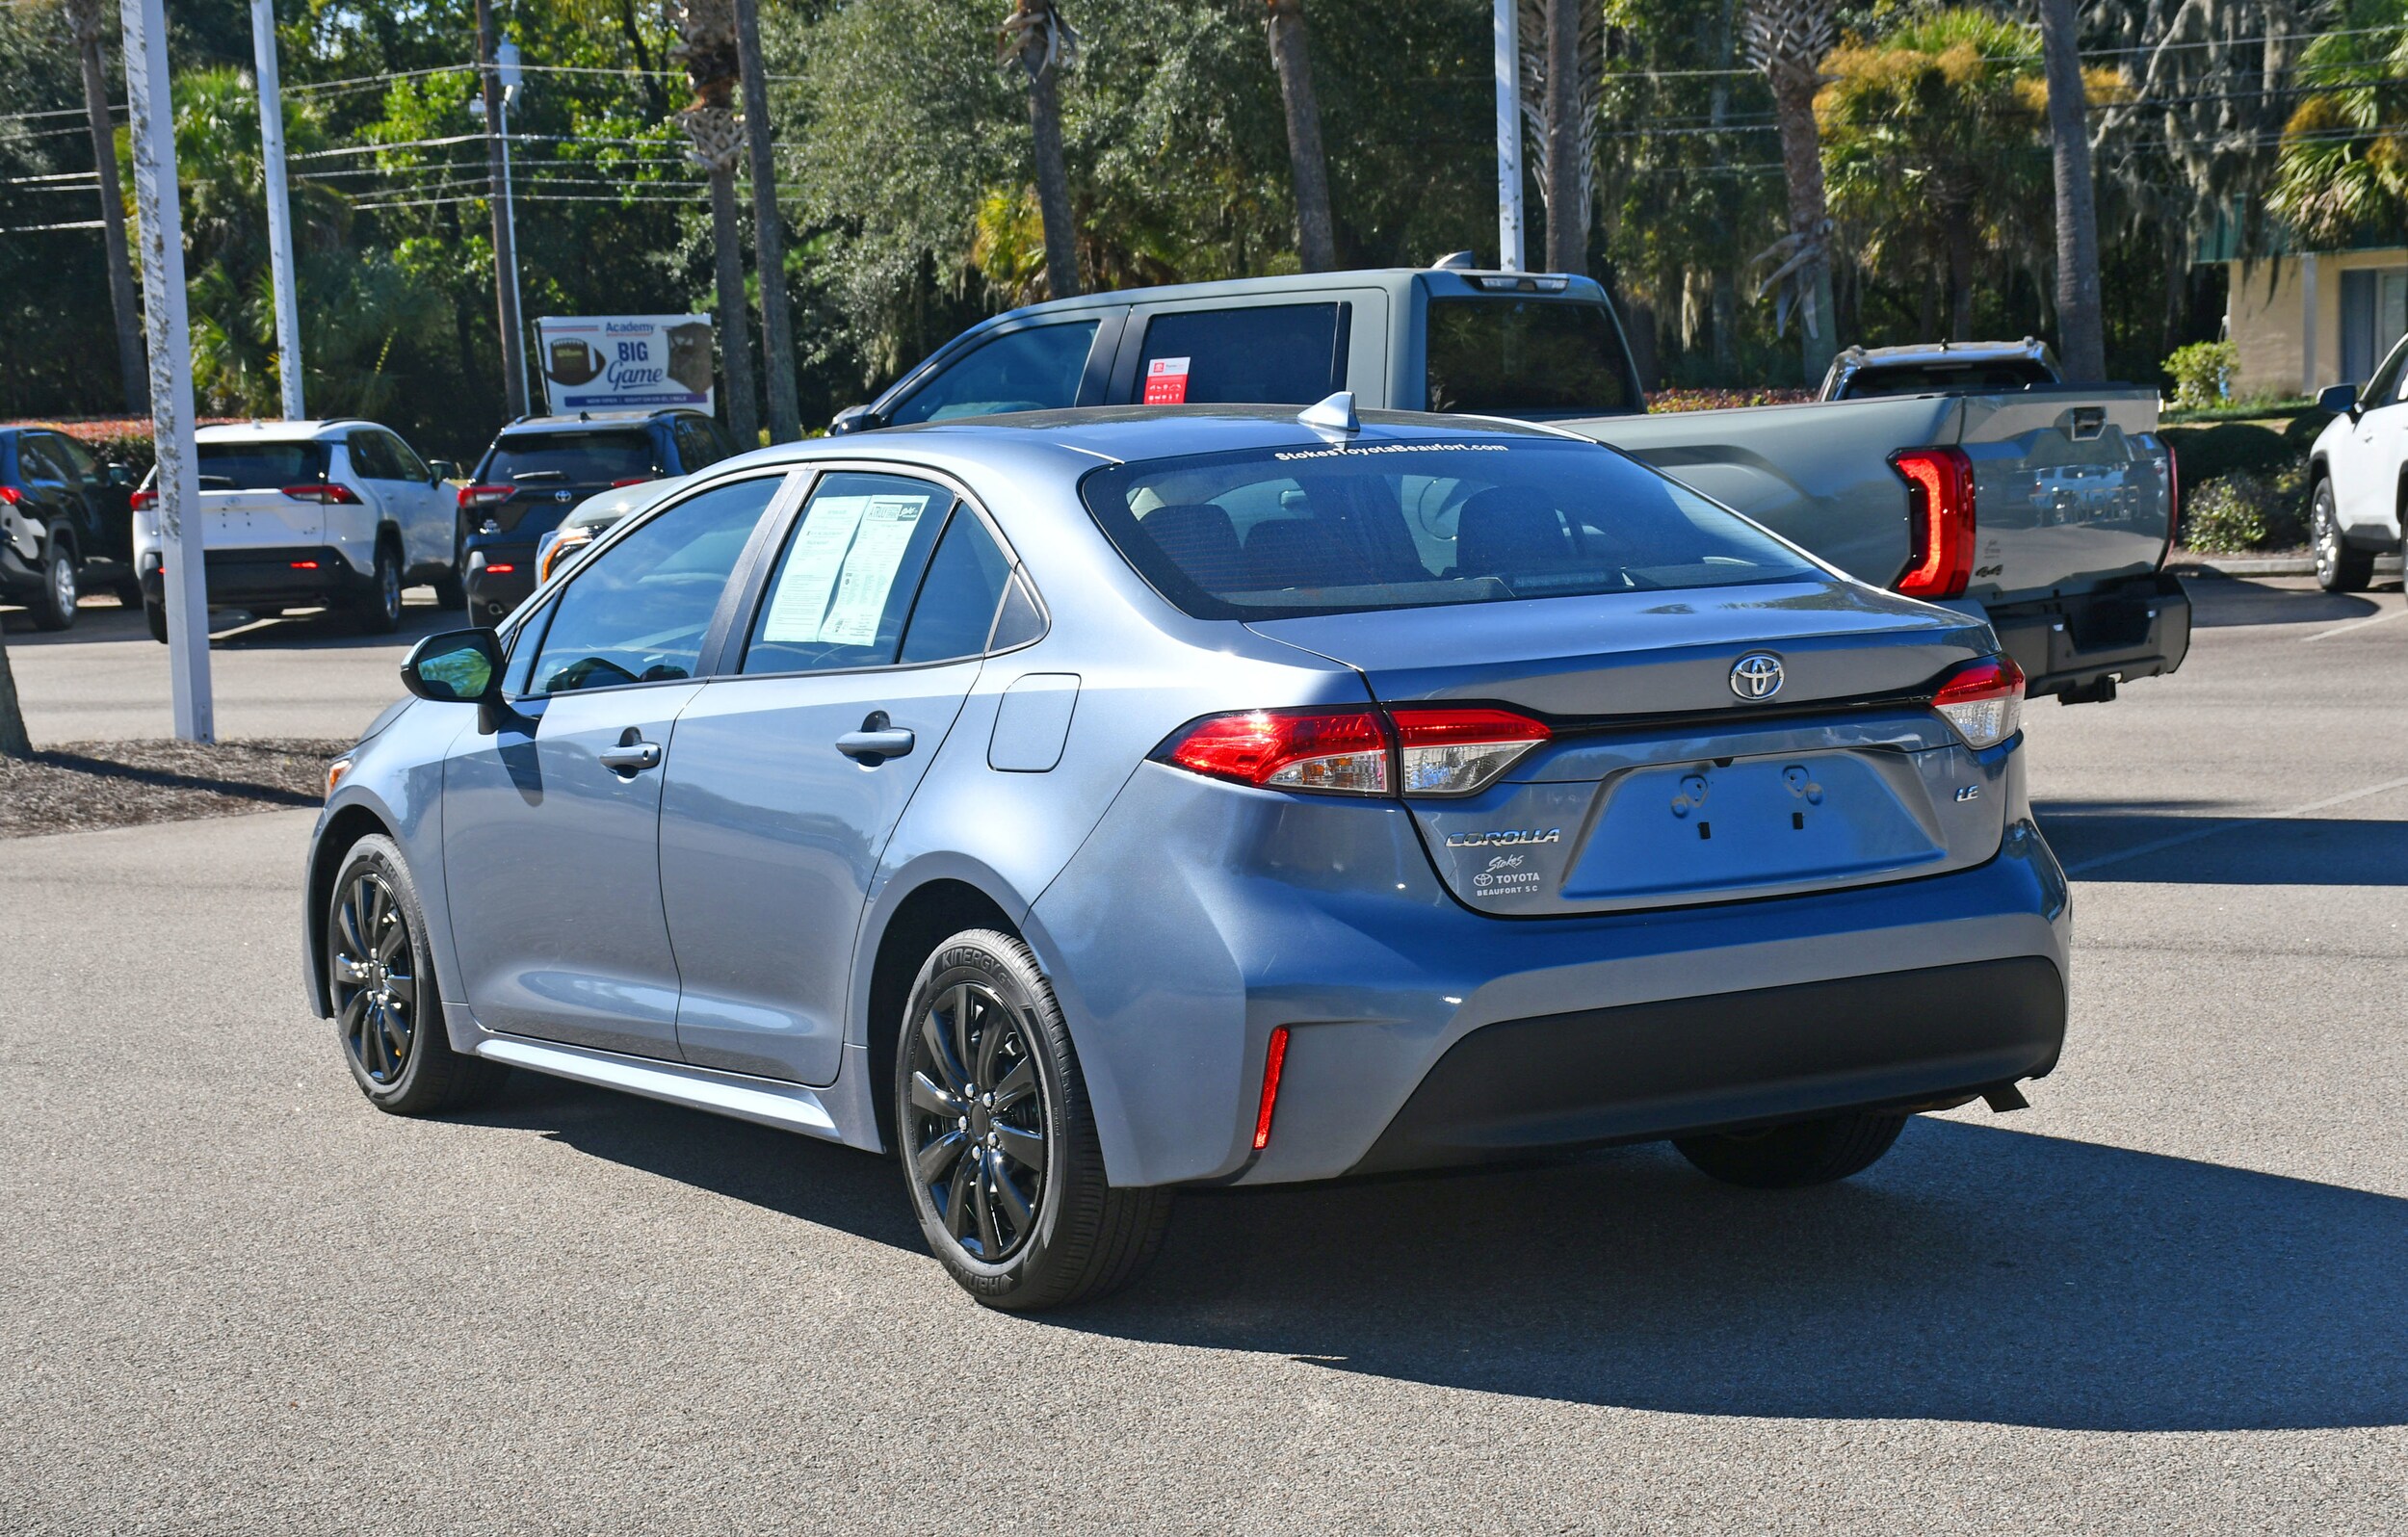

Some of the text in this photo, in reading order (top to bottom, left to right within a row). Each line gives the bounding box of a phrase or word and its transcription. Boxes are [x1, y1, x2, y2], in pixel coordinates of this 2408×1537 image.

[606, 321, 656, 335] Academy
[617, 341, 649, 362] BIG
[607, 360, 664, 391] Game
[1274, 443, 1509, 461] StokesToyotaBeaufort.com
[1954, 785, 1979, 802] LE
[1445, 828, 1560, 847] COROLLA
[1485, 854, 1524, 873] Stokes
[1496, 872, 1540, 884] TOYOTA
[1477, 886, 1522, 897] BEAUFORT
